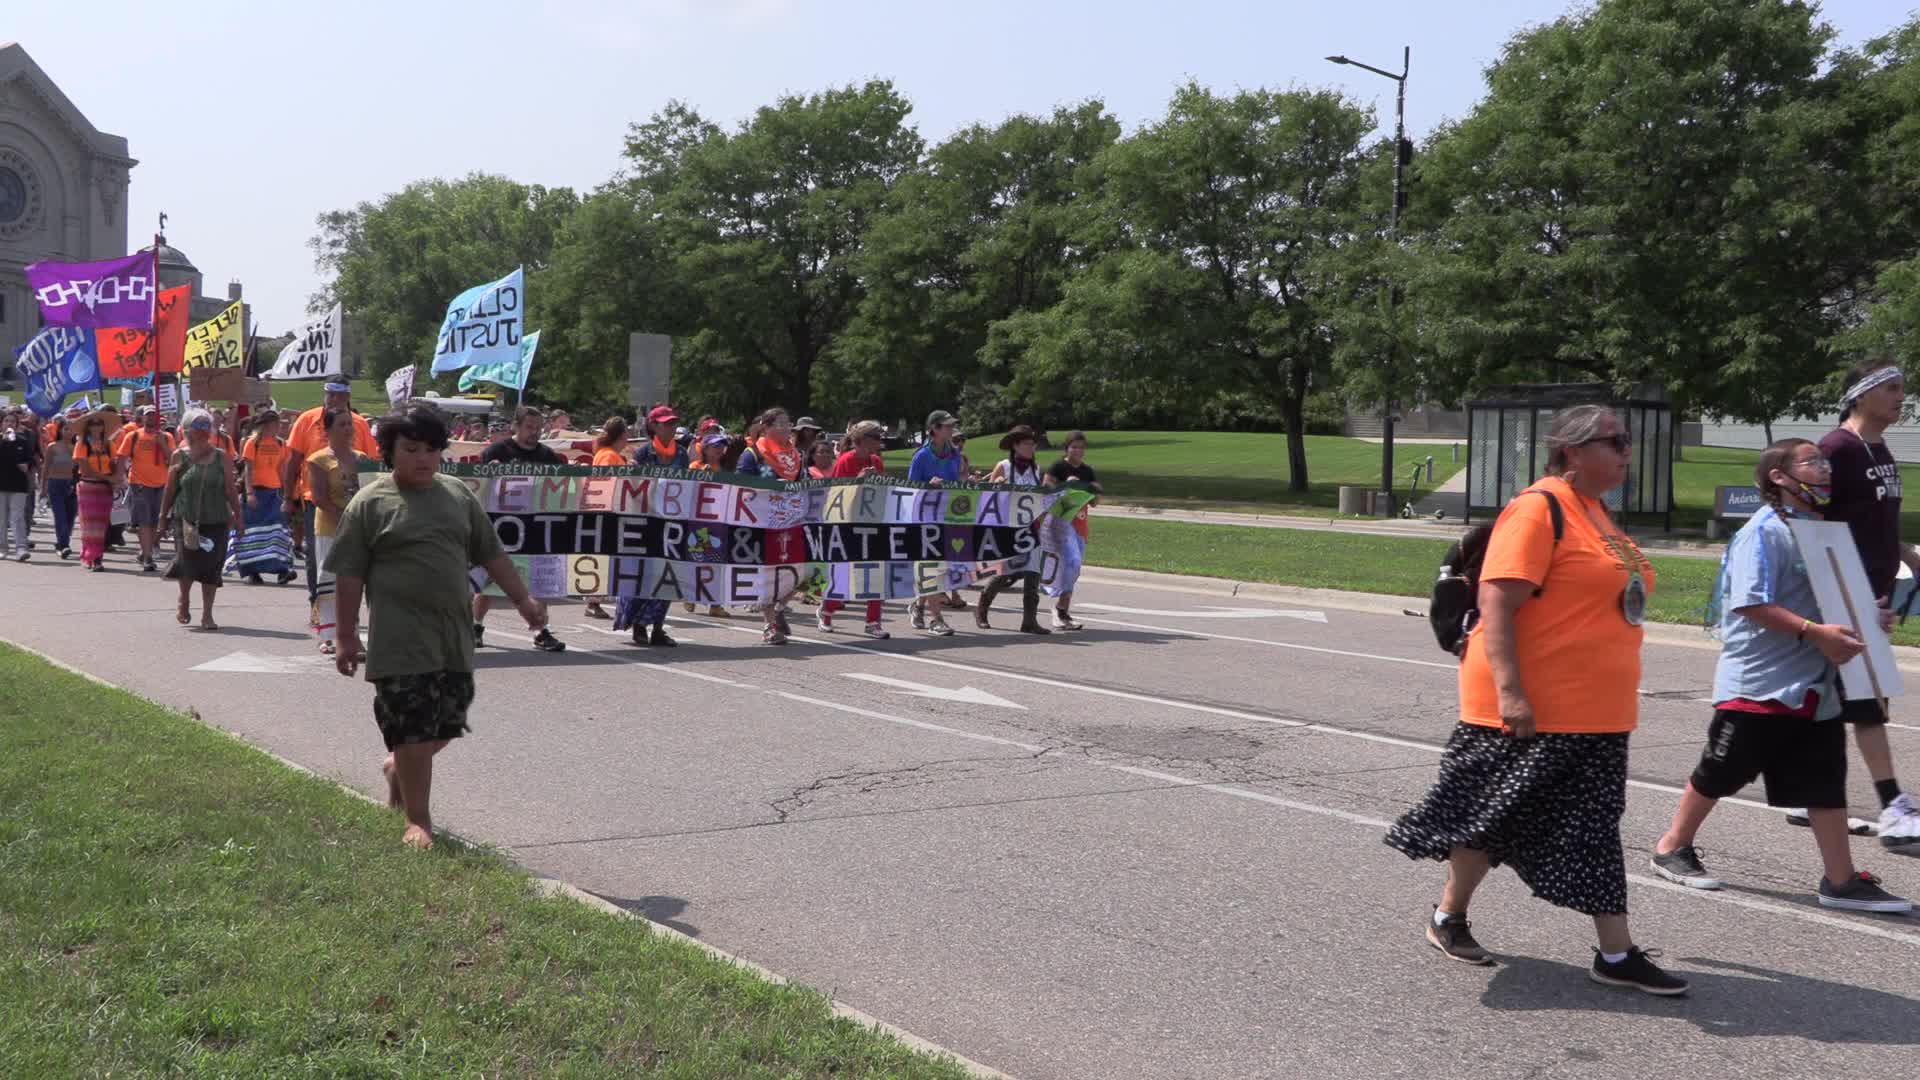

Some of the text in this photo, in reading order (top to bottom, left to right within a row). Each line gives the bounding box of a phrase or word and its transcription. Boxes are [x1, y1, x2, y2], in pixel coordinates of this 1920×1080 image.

[473, 464, 561, 476] SOVEREIGNTY
[592, 466, 634, 477] BLACK
[641, 465, 714, 480] LIBERATION
[805, 486, 943, 523] EARTH
[979, 492, 1034, 526] AS
[494, 514, 684, 559] OTHER
[803, 525, 942, 560] WATER
[978, 528, 1037, 560] AS
[574, 555, 798, 602] SHARED
[827, 562, 940, 601] LIFE
